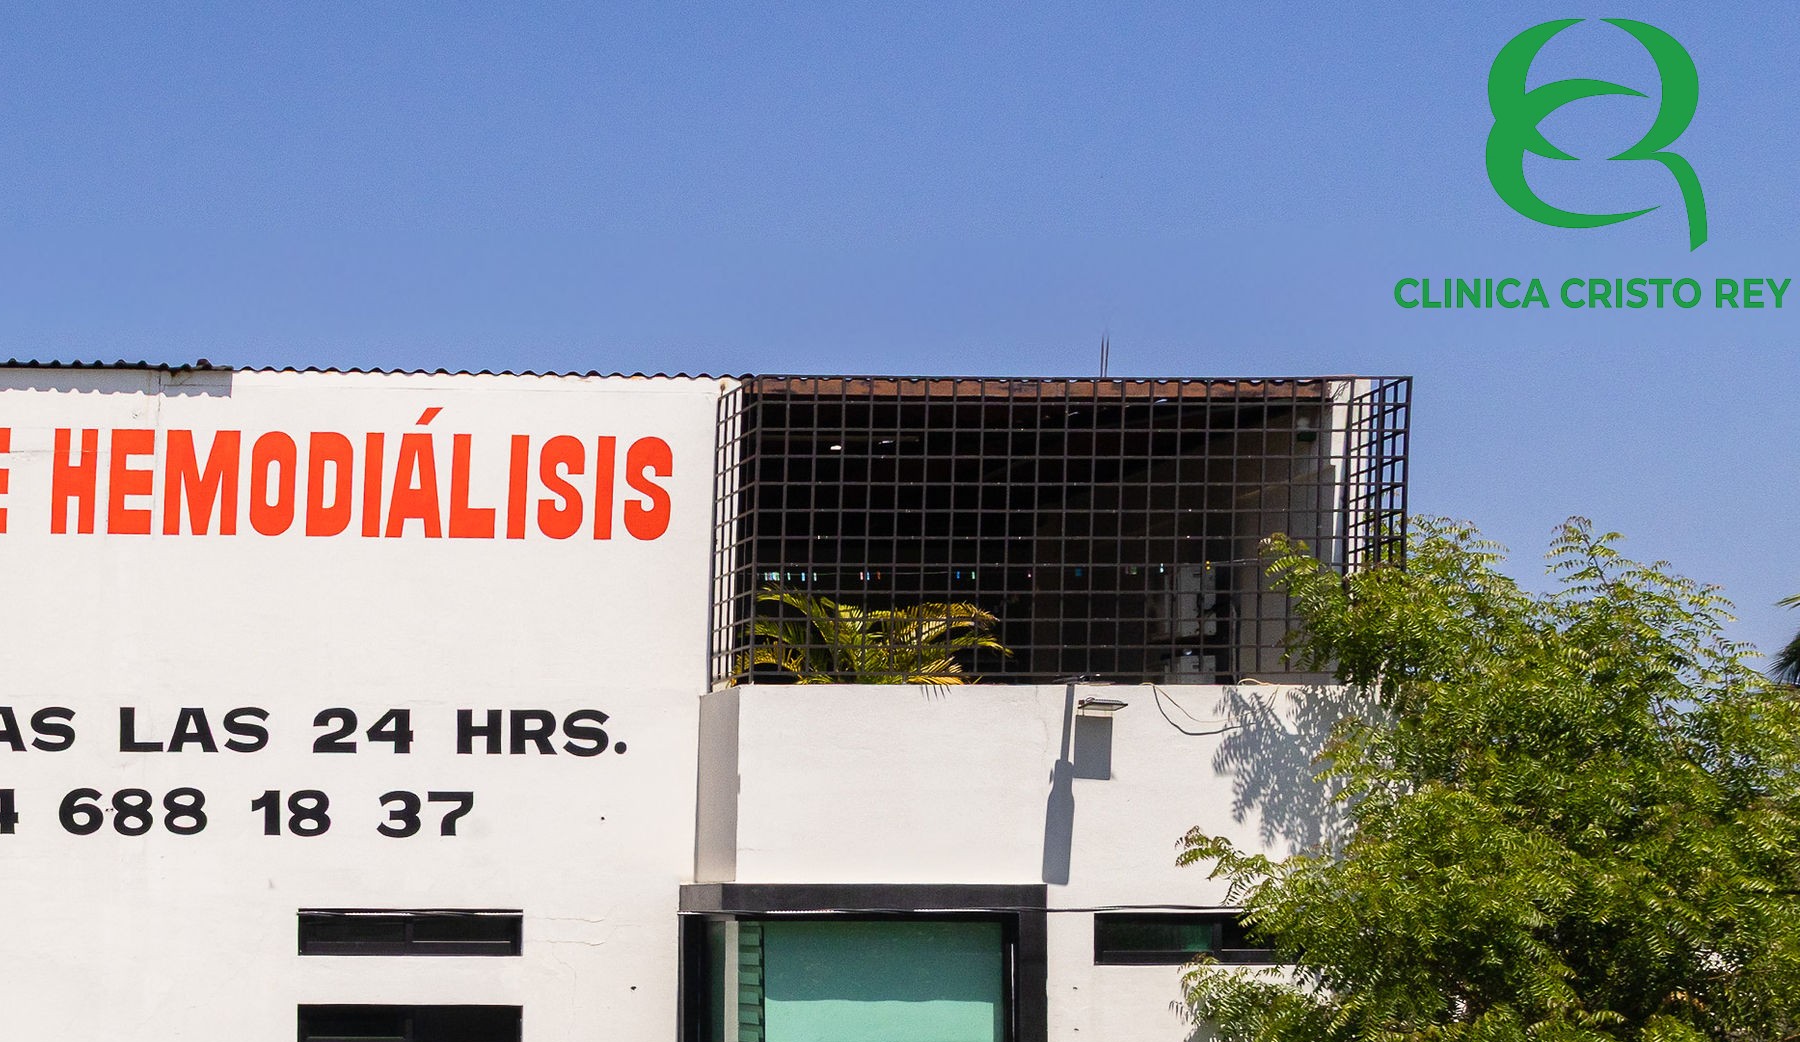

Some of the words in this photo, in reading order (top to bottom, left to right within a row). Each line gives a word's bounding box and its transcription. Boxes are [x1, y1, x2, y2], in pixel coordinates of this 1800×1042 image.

[50, 406, 673, 541] HEMODIÁLISIS
[119, 706, 270, 753] LAS
[312, 707, 414, 754] 24
[456, 709, 627, 757] HRS.
[58, 787, 208, 837] 688
[251, 789, 331, 837] 18
[376, 790, 474, 839] 37
